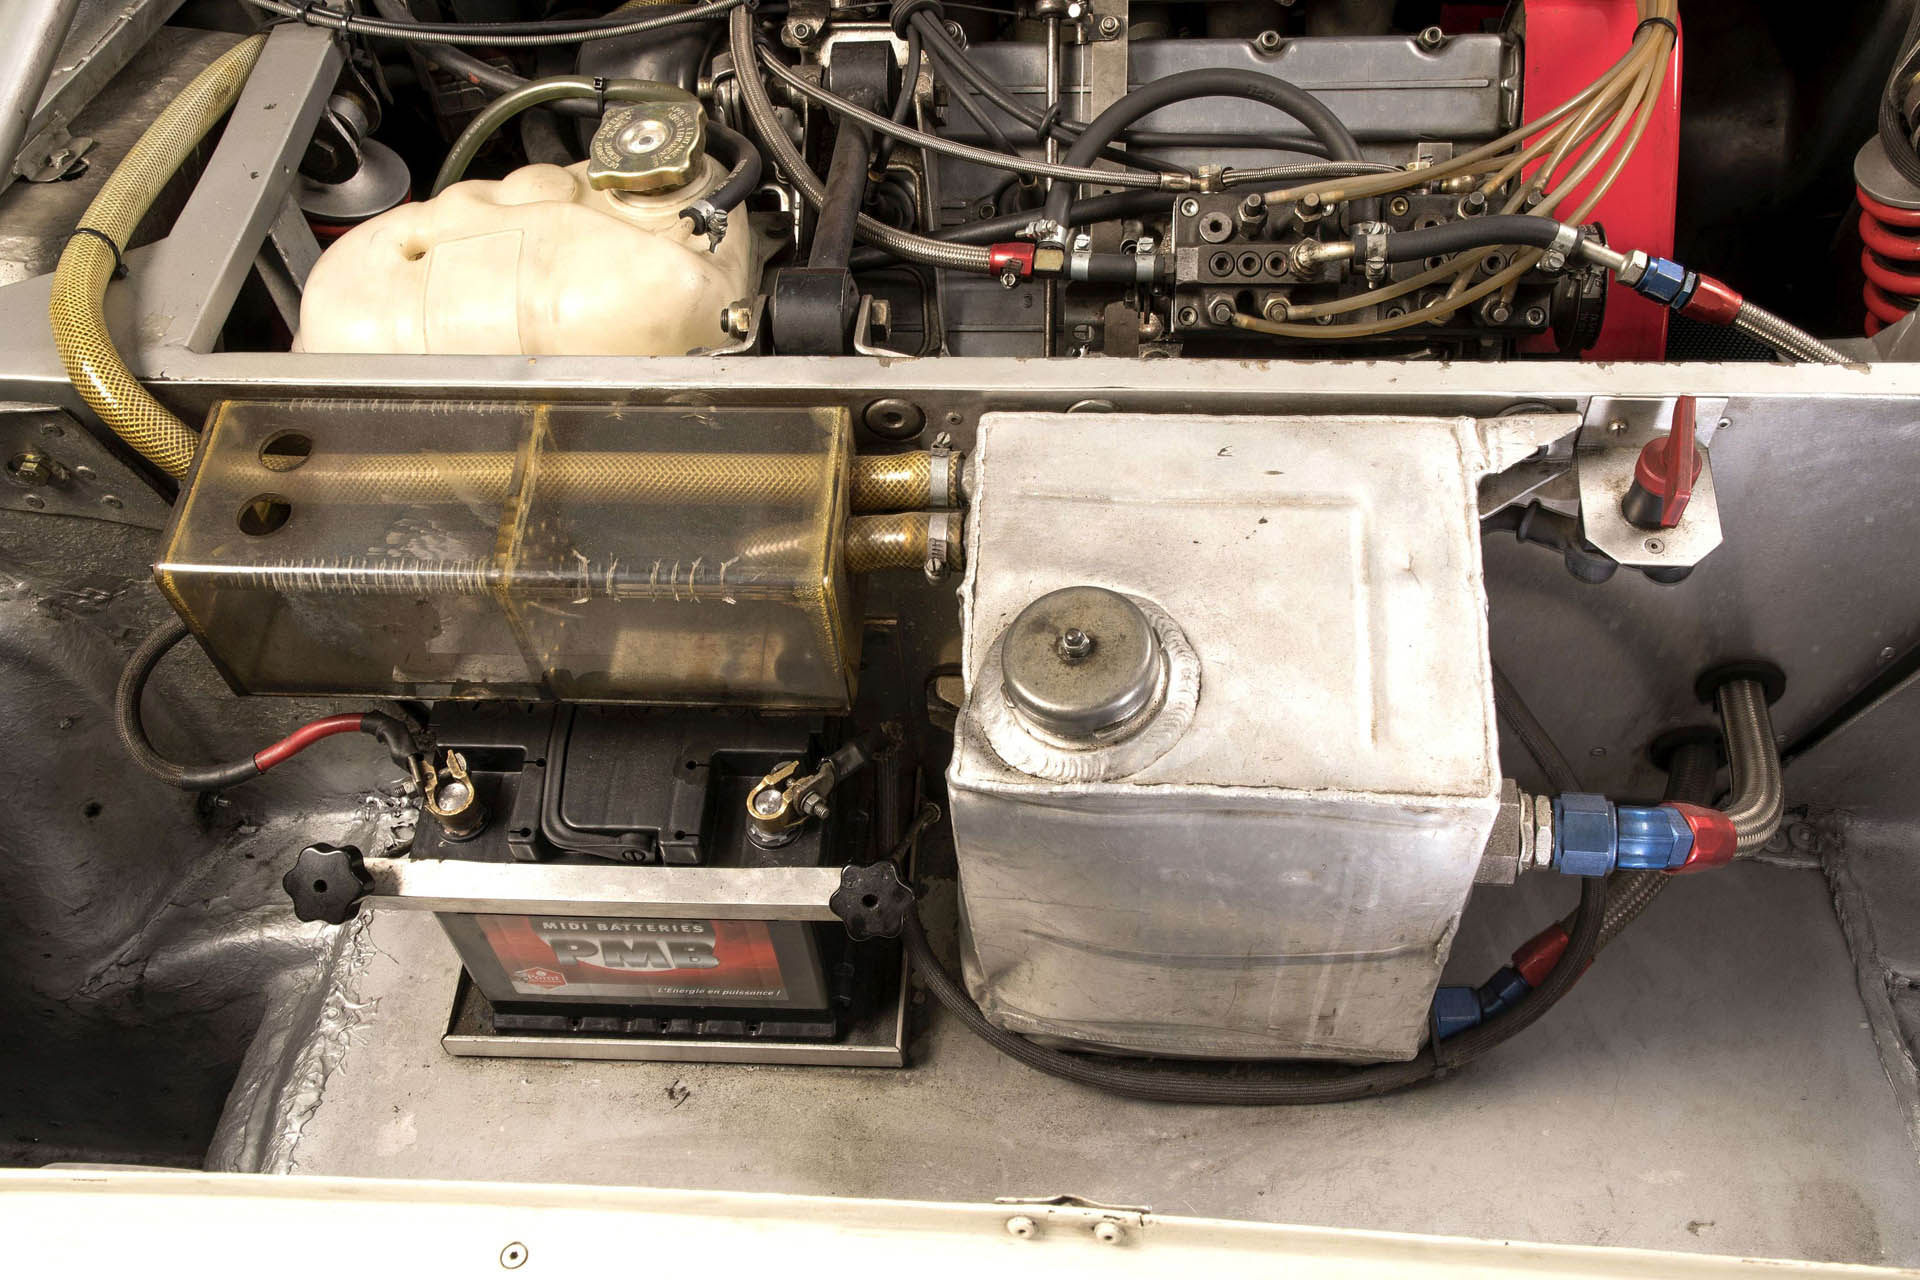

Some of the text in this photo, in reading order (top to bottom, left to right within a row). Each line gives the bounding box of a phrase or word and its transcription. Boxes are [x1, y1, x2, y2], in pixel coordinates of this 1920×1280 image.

[542, 921, 705, 934] MIDI BATTERIES
[548, 937, 719, 969] PMB
[722, 989, 774, 998] puissance
